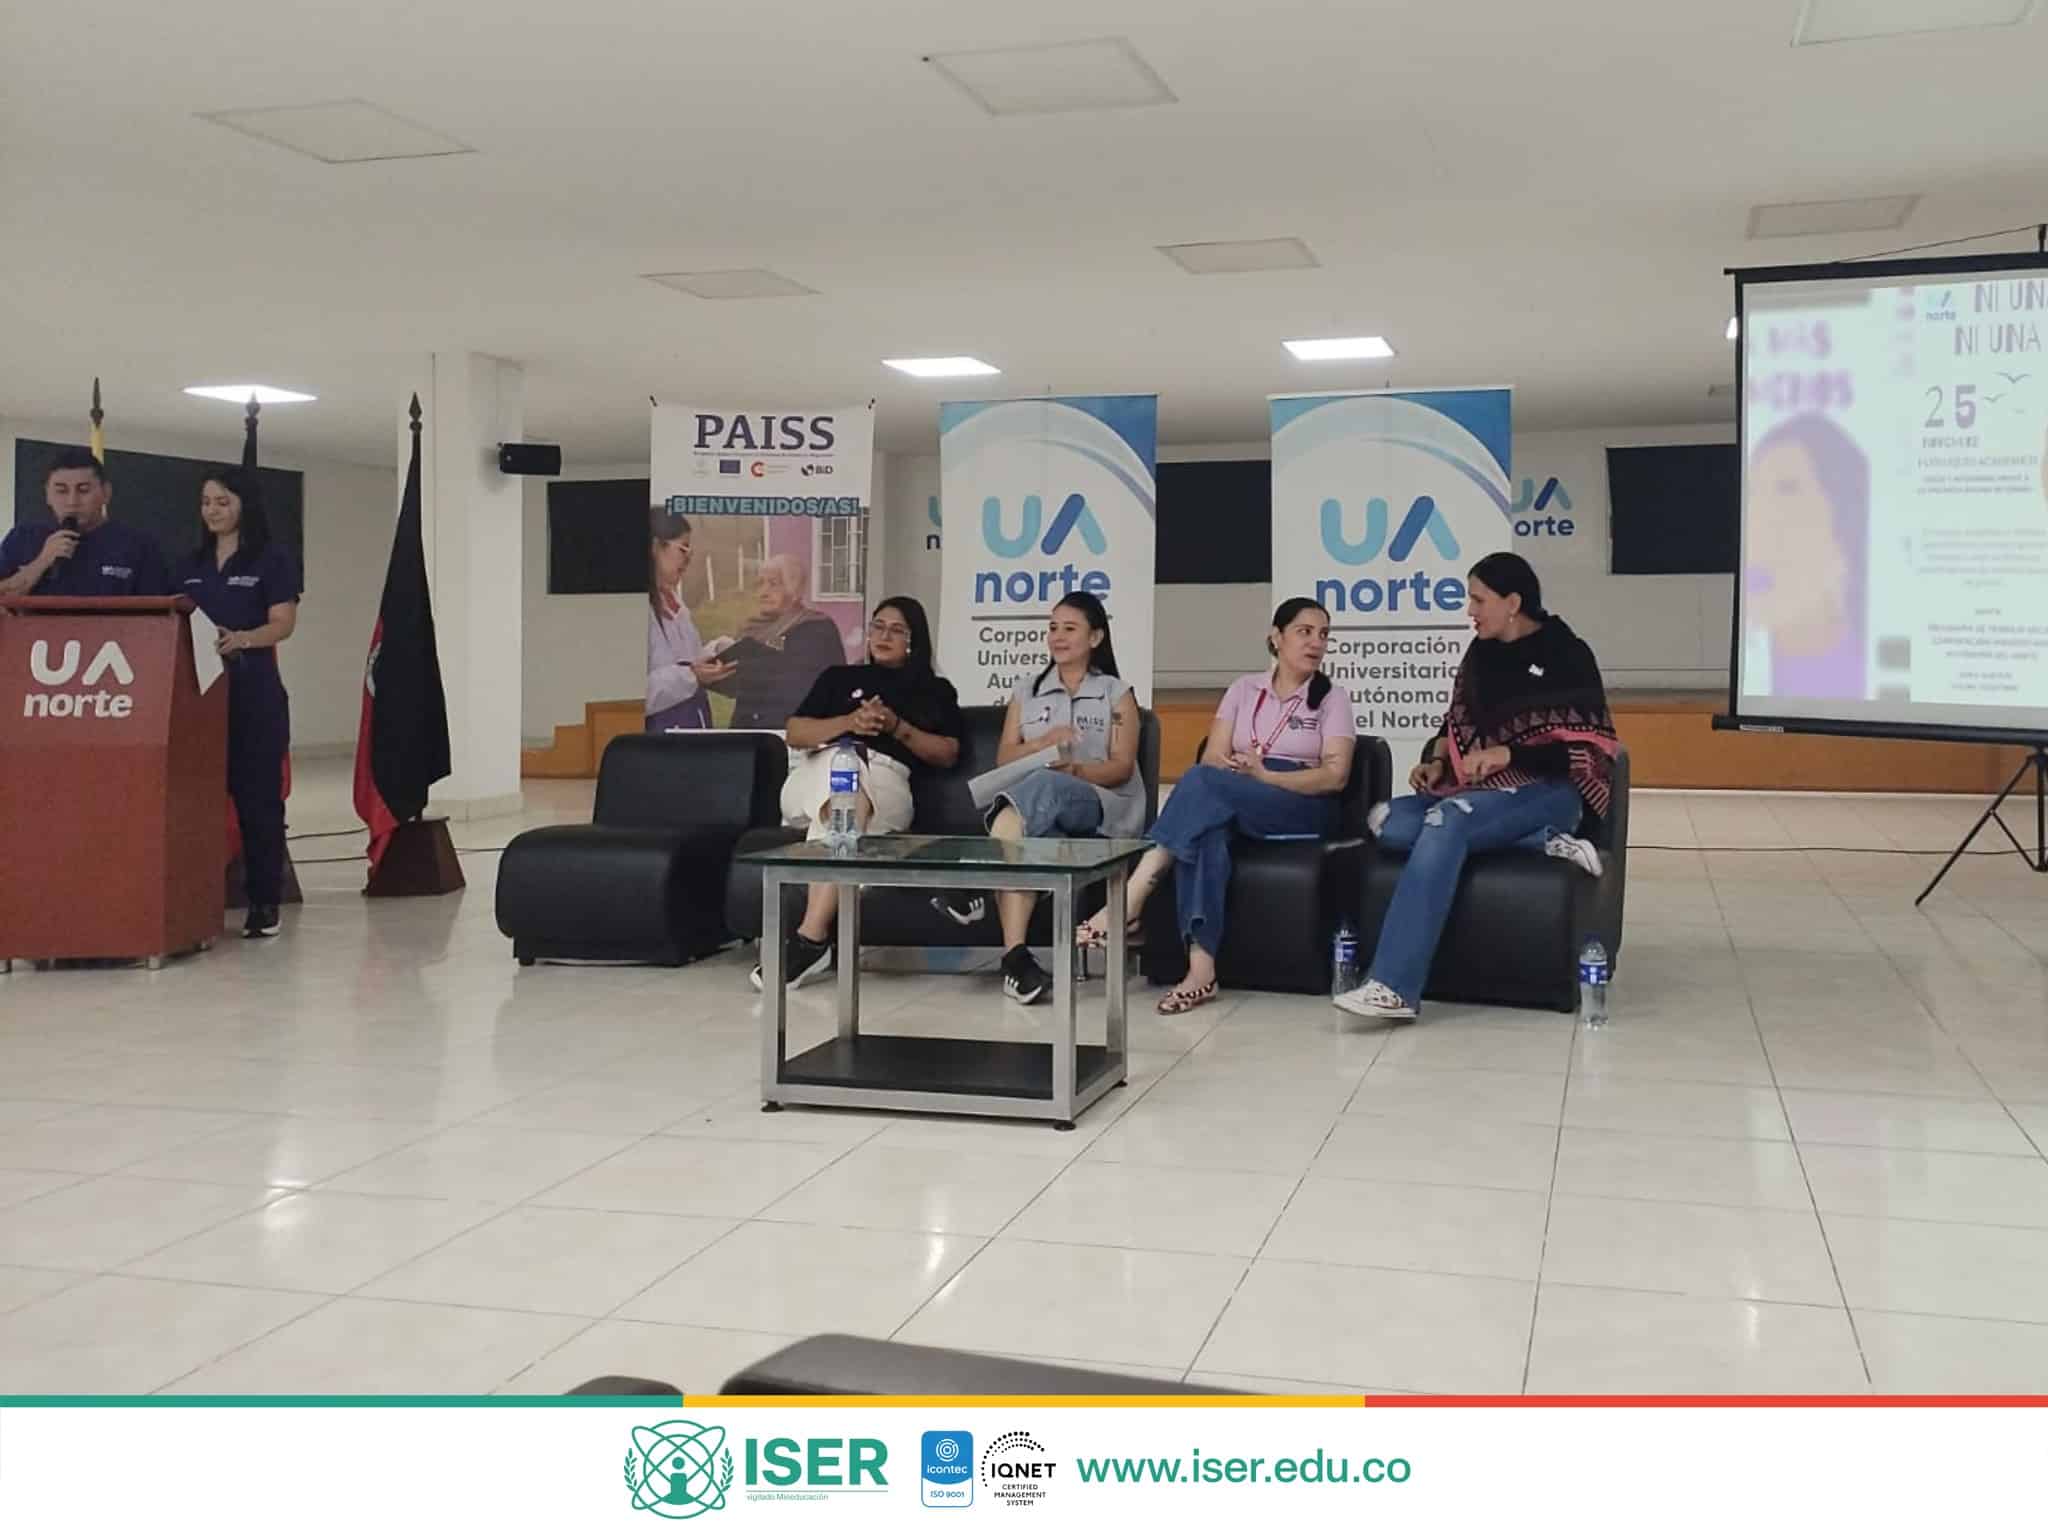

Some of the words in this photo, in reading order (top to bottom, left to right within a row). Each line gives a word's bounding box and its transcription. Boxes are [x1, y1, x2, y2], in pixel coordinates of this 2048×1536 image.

[2008, 280, 2048, 311] UN
[1989, 321, 2042, 354] UNA
[1924, 384, 1977, 429] 25
[694, 414, 834, 449] PAISS
[982, 493, 1107, 558] UA
[1320, 495, 1461, 566] UA
[1511, 516, 1575, 536] orte
[975, 564, 1111, 603] norte
[1315, 571, 1466, 612] norte
[979, 627, 1047, 647] Corpor
[1326, 636, 1461, 659] Corporación
[31, 640, 134, 685] UA
[977, 649, 1049, 666] Univers
[23, 690, 133, 718] norte
[1350, 686, 1449, 704] utónoma
[1355, 710, 1374, 728] el
[1381, 711, 1444, 728] Norte
